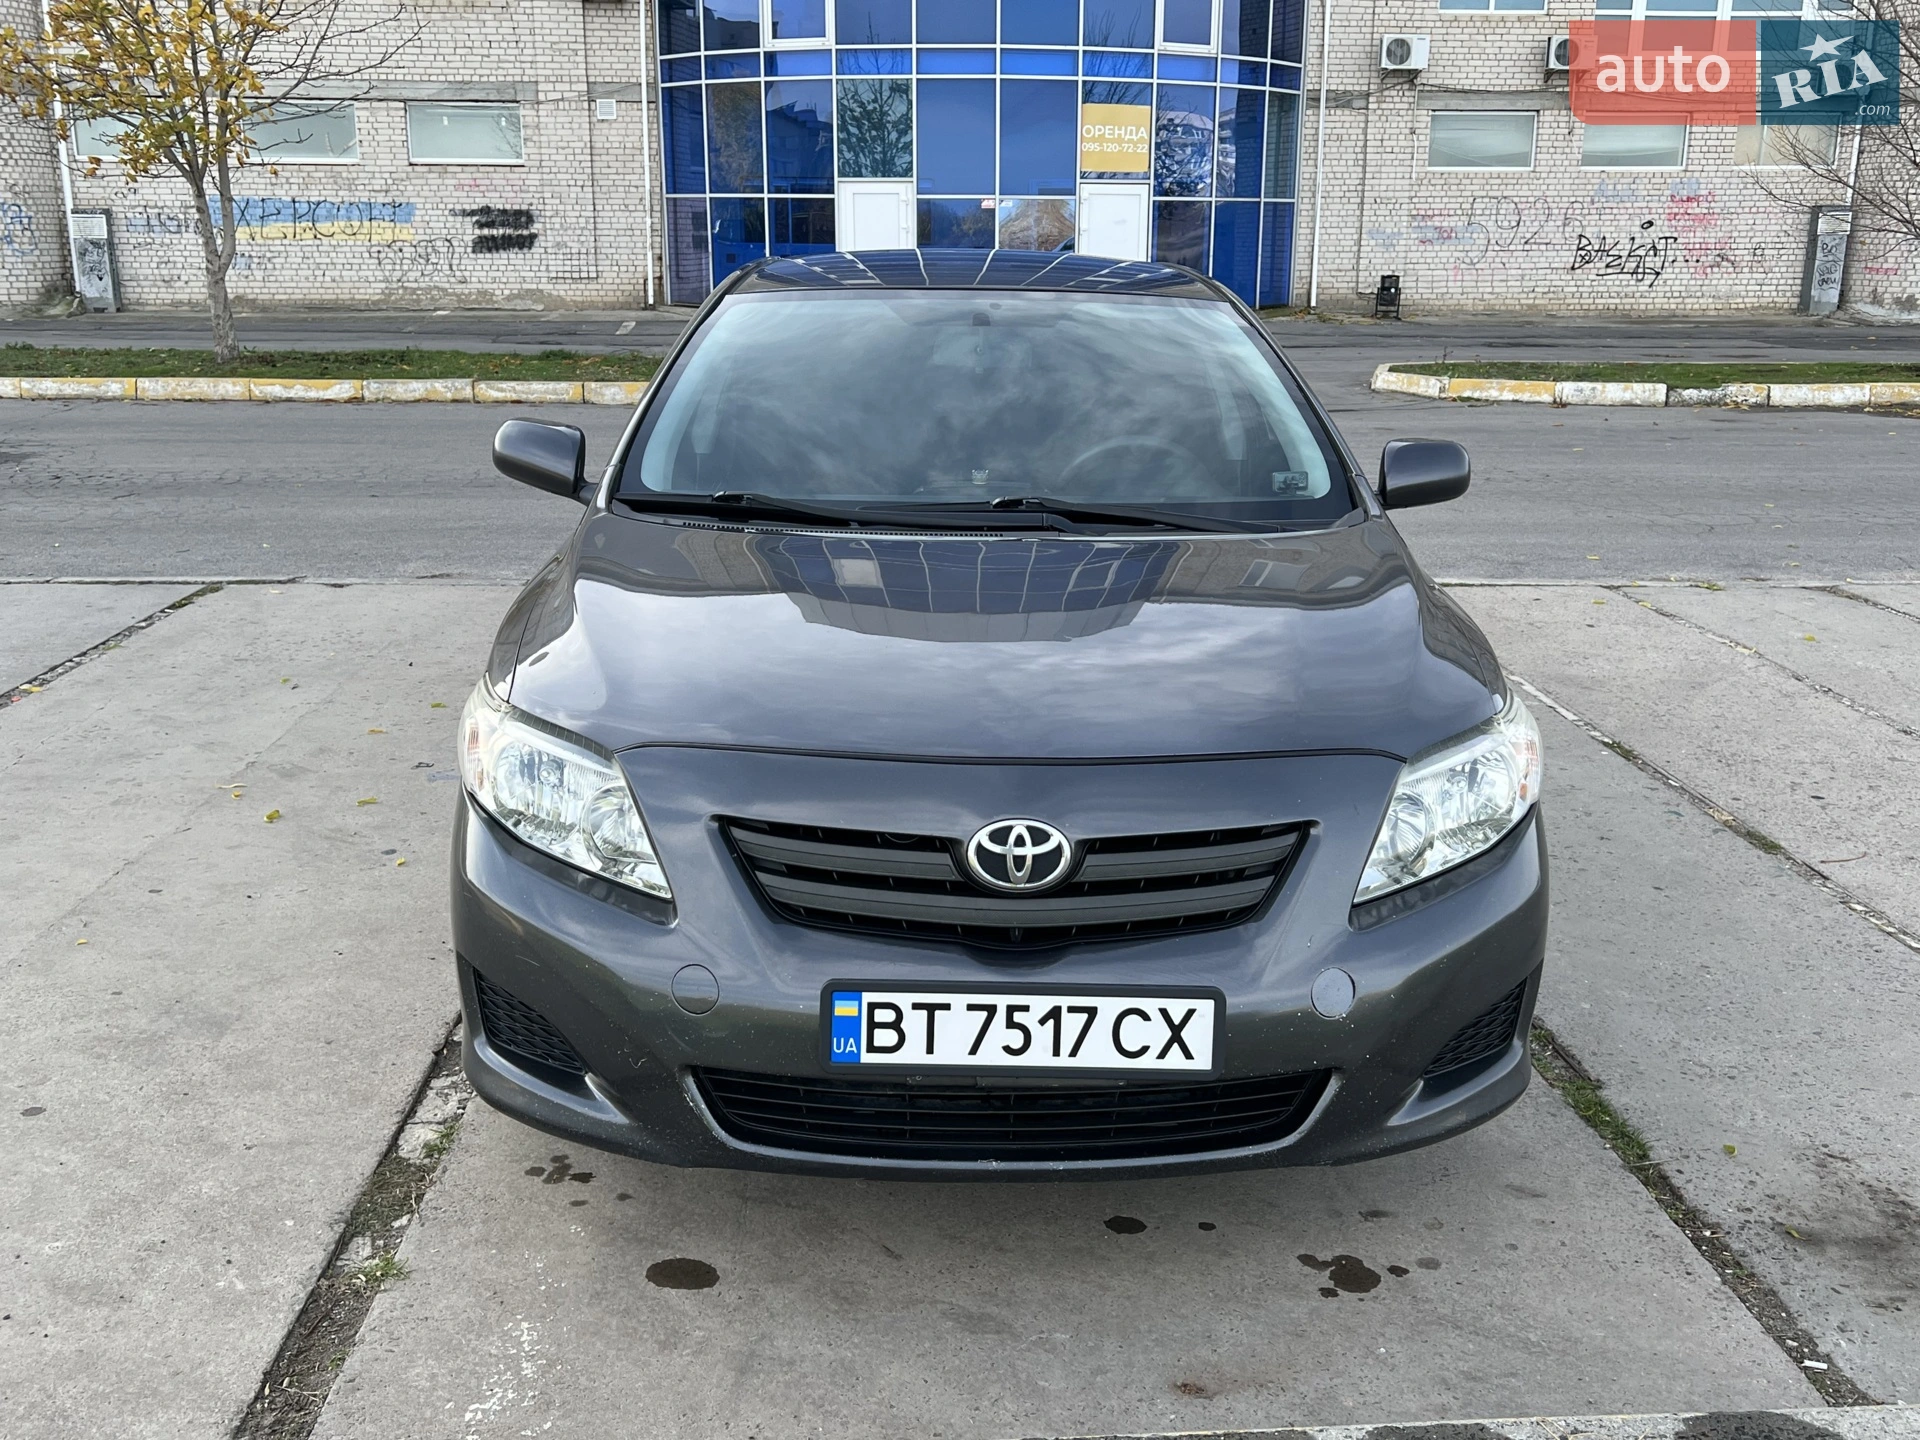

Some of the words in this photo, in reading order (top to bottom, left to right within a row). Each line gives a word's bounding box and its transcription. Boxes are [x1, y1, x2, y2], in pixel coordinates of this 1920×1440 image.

[1082, 125, 1148, 141] ОРЕНДА
[1081, 142, 1148, 153] 095-120-72-22
[866, 1001, 951, 1055] BT
[966, 1003, 1098, 1058] 7517
[1112, 1007, 1198, 1061] CX
[833, 1037, 857, 1054] UA
